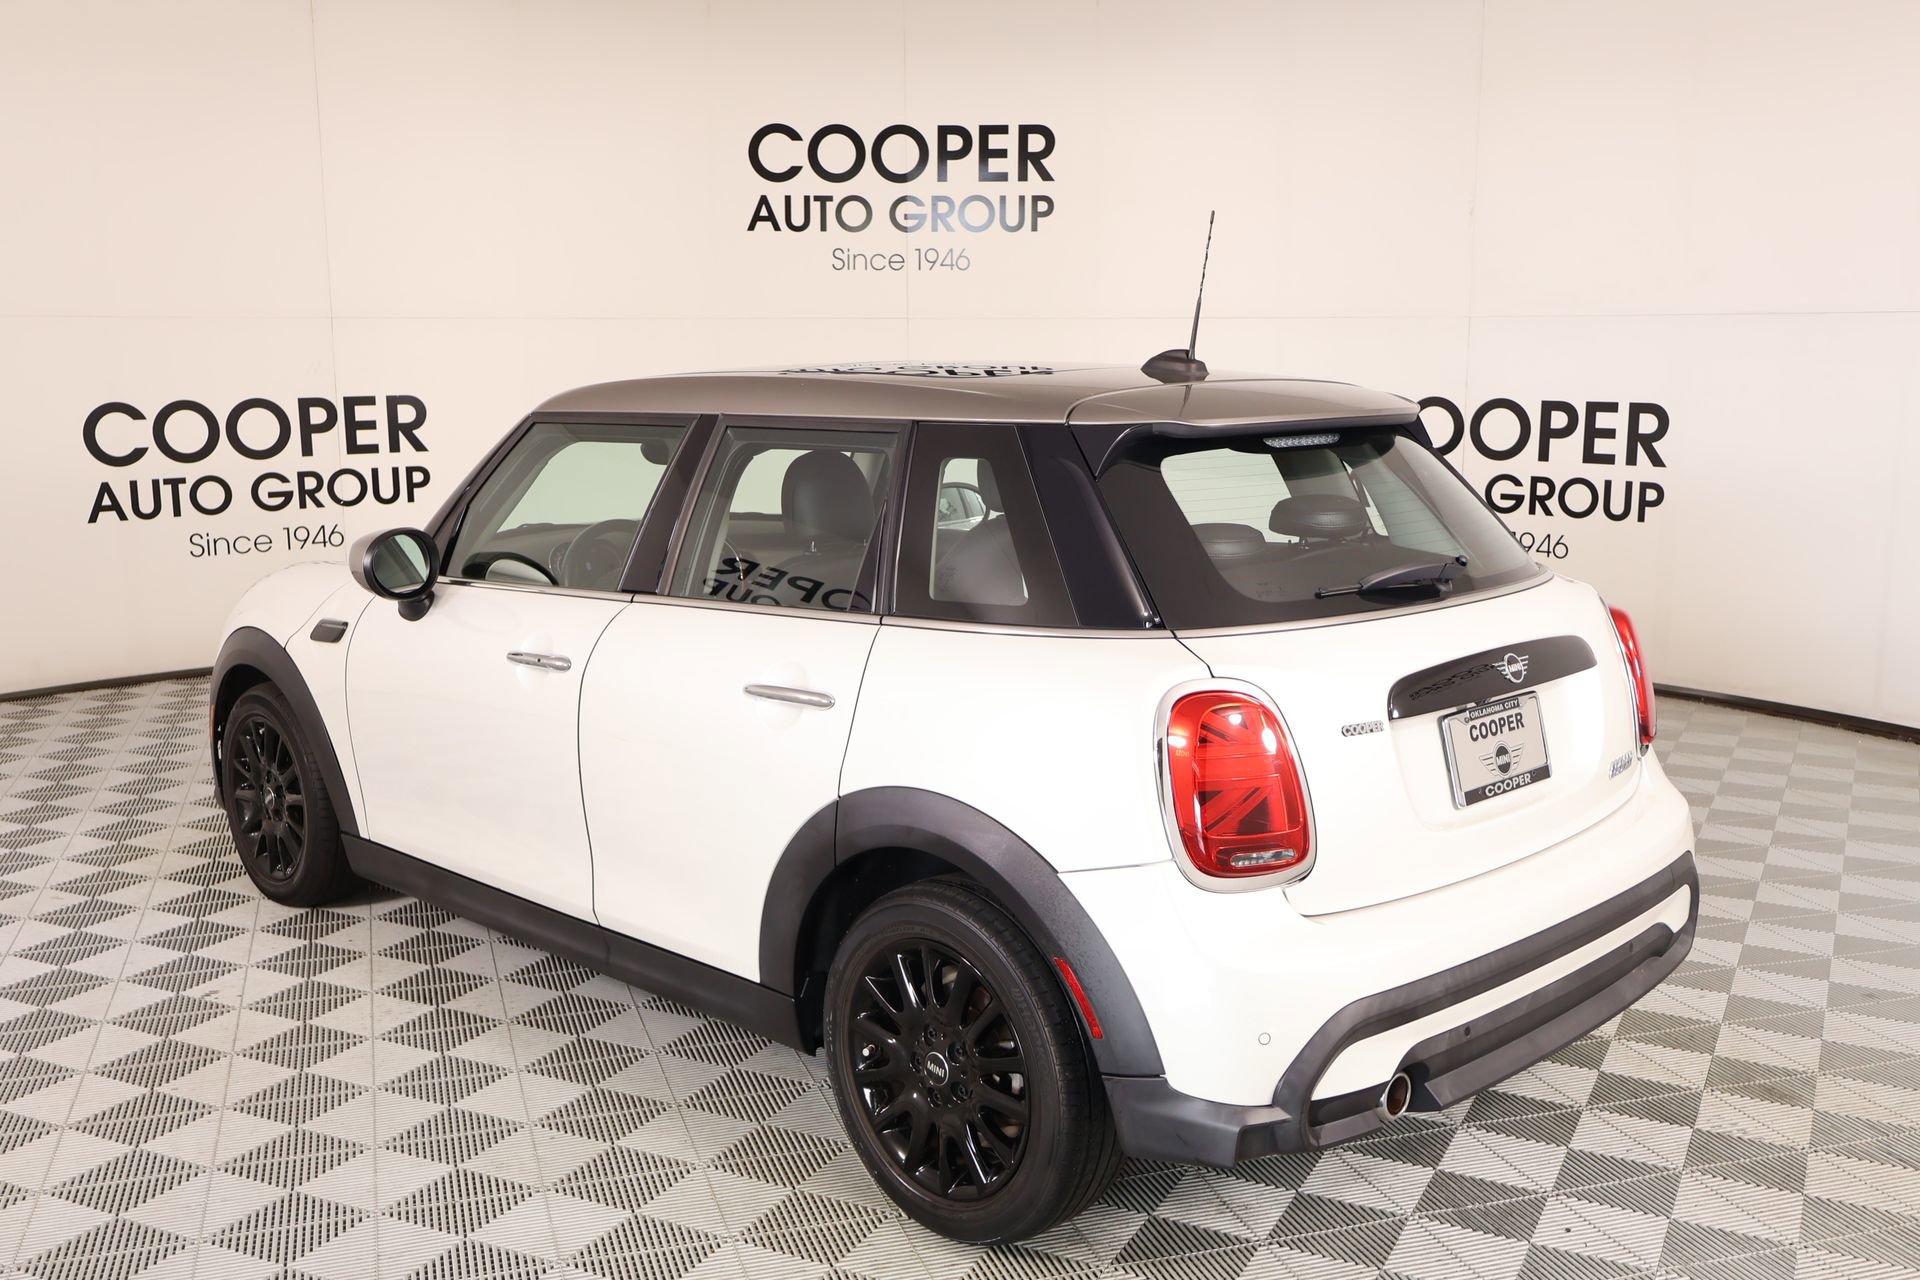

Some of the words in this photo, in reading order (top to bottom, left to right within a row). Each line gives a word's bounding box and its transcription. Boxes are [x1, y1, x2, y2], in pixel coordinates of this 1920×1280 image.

[748, 123, 1056, 183] COOPER
[747, 195, 873, 232] AUTO
[889, 195, 1054, 233] GROUP
[832, 248, 905, 271] Since
[915, 248, 970, 271] 1946
[83, 395, 429, 467] COOPER
[1417, 396, 1670, 468] OOPER
[87, 475, 233, 524] AUTO
[251, 465, 431, 512] GROUP
[1485, 474, 1665, 522] GROUP
[189, 532, 273, 557] Since
[282, 523, 345, 551] 1946
[1511, 531, 1569, 560] 946
[1470, 704, 1504, 719] OKLAHOMA
[1504, 700, 1518, 710] CITY
[1341, 720, 1385, 737] COOPER
[1469, 712, 1525, 742] COOPER
[1496, 753, 1510, 766] MINI
[1485, 773, 1532, 796] COOPER
[927, 1060, 945, 1078] MINI
